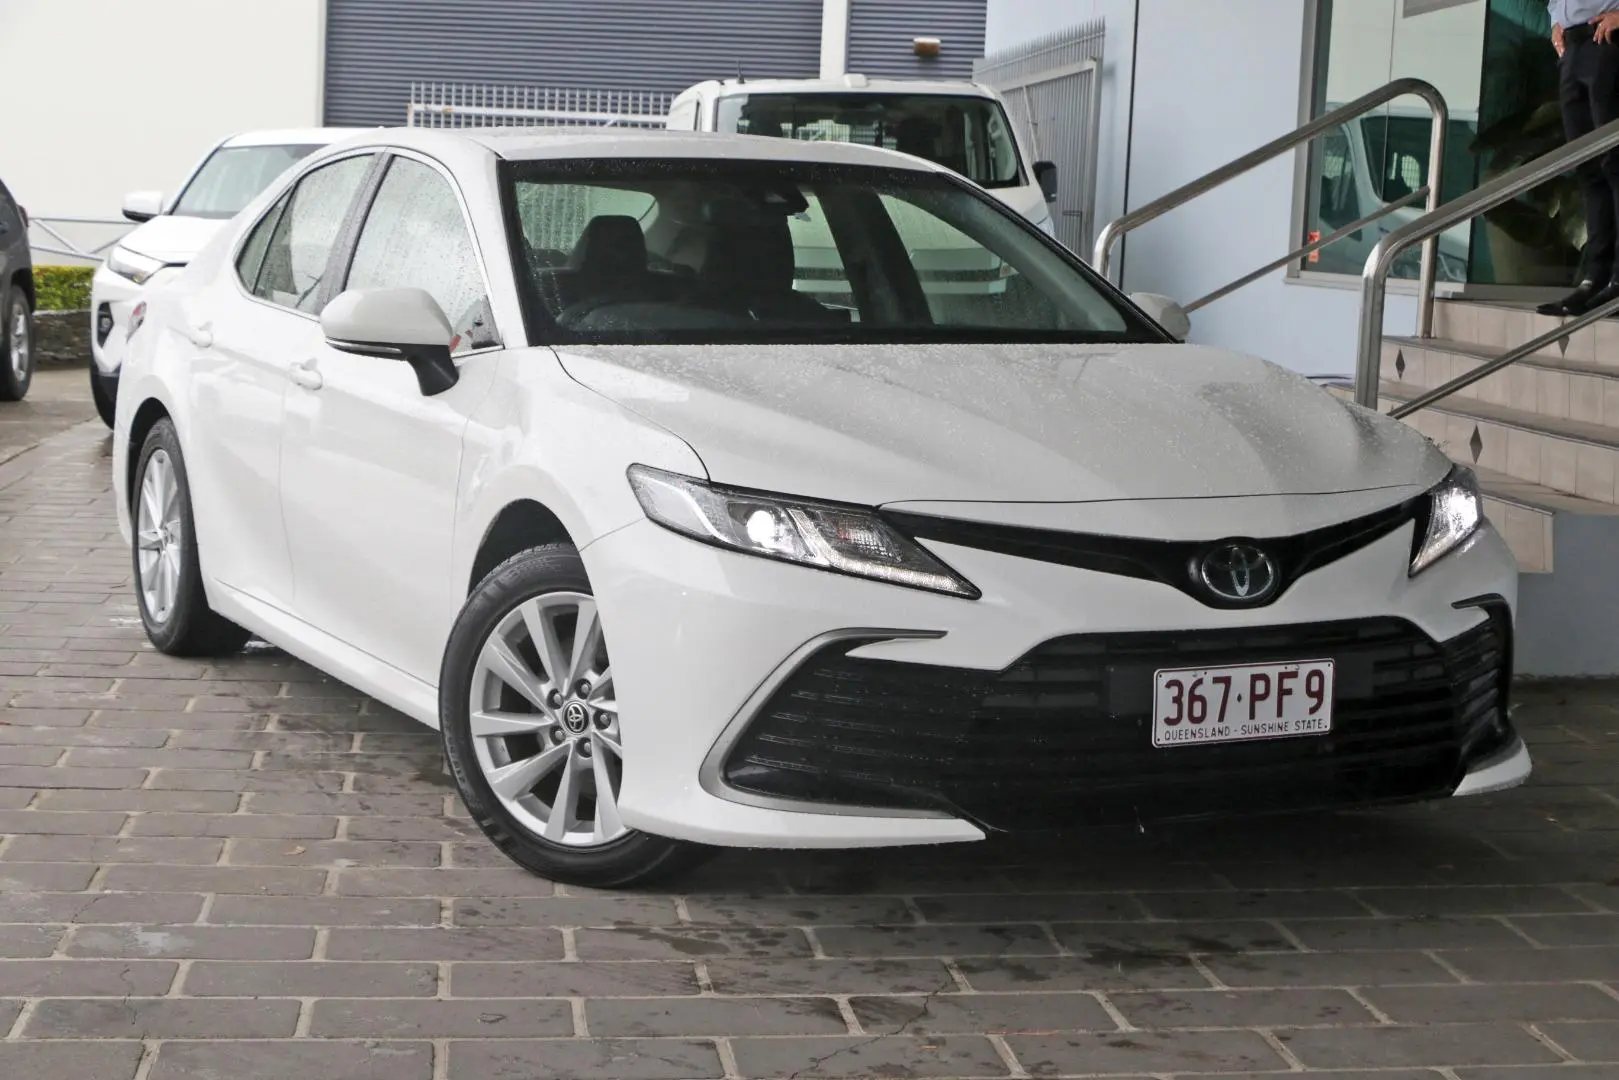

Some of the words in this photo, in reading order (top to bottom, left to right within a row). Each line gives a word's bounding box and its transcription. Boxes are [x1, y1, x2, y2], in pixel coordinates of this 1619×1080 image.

[1164, 726, 1231, 742] QUEENSLAND
[1240, 721, 1289, 736] SUNSHINE
[1294, 718, 1323, 731] STATE
